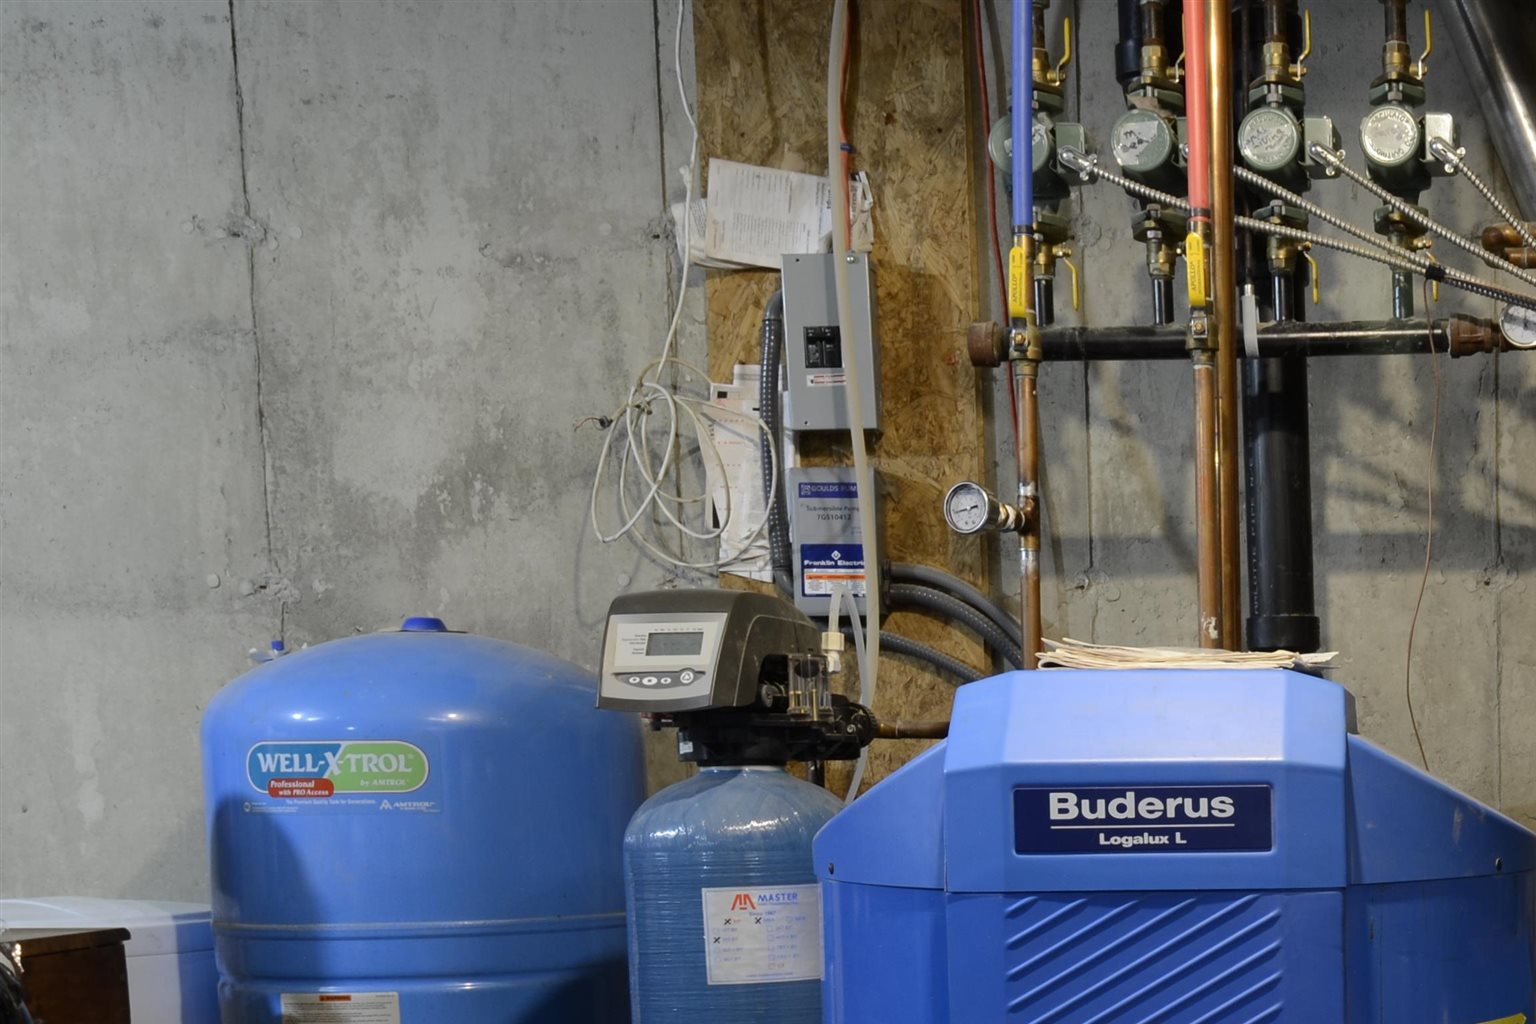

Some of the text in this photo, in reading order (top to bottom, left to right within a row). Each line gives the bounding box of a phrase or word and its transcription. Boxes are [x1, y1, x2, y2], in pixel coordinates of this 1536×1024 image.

[803, 559, 835, 567] Franklin
[270, 780, 315, 789] Professional
[1049, 791, 1236, 820] Buderus
[1099, 831, 1188, 848] Logalux L
[757, 892, 799, 903] MASTER
